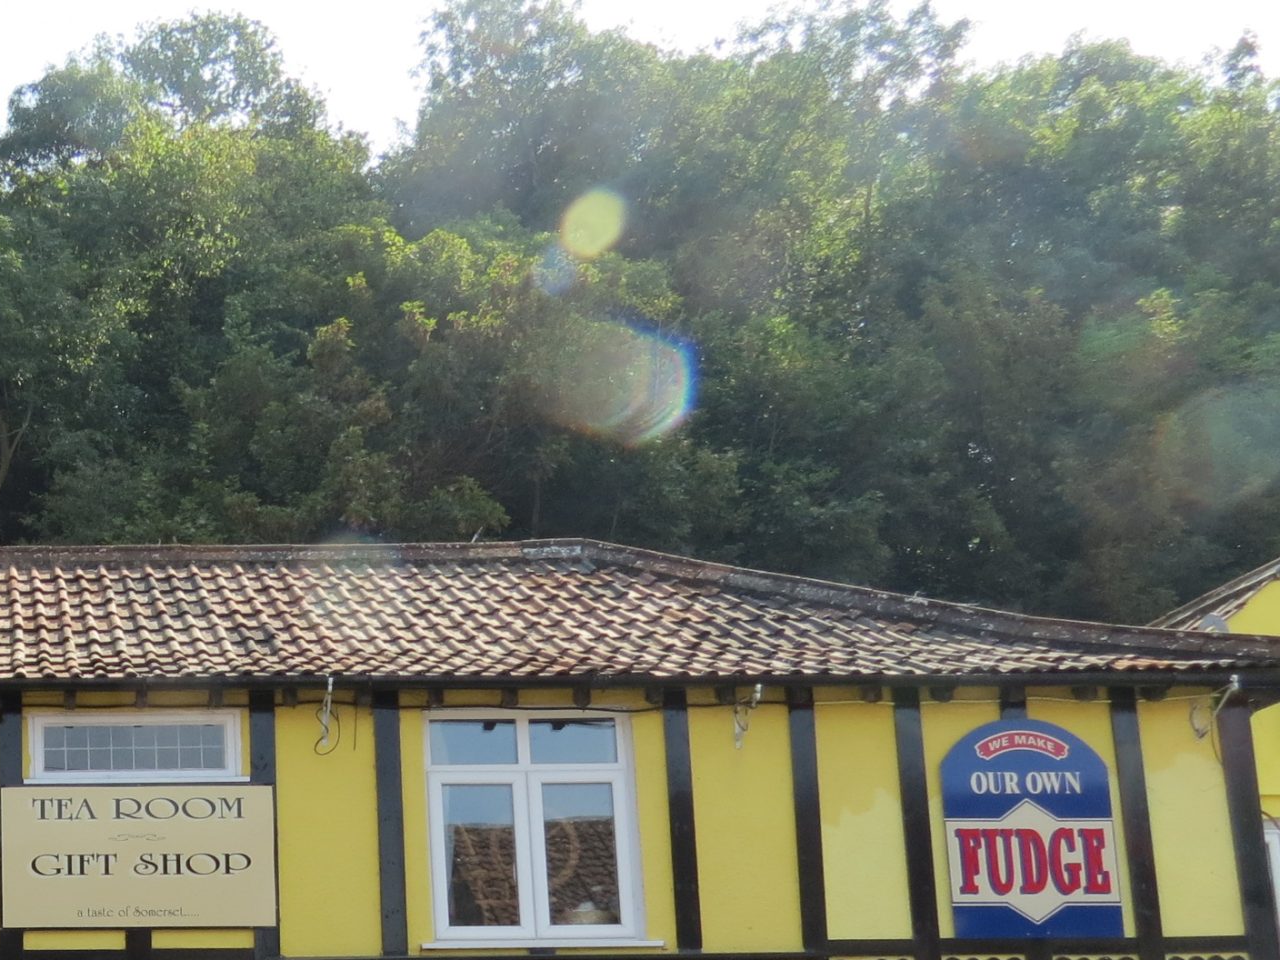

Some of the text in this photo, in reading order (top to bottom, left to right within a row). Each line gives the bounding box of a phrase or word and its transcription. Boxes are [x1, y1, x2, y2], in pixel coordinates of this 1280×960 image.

[987, 734, 1056, 752] WE MAKE
[970, 771, 1081, 795] OUR OWN
[31, 796, 245, 822] TEA ROOM
[30, 851, 253, 877] GIFT SHOP
[955, 826, 1112, 896] FUDGE
[87, 907, 115, 918] taste
[118, 906, 131, 918] of
